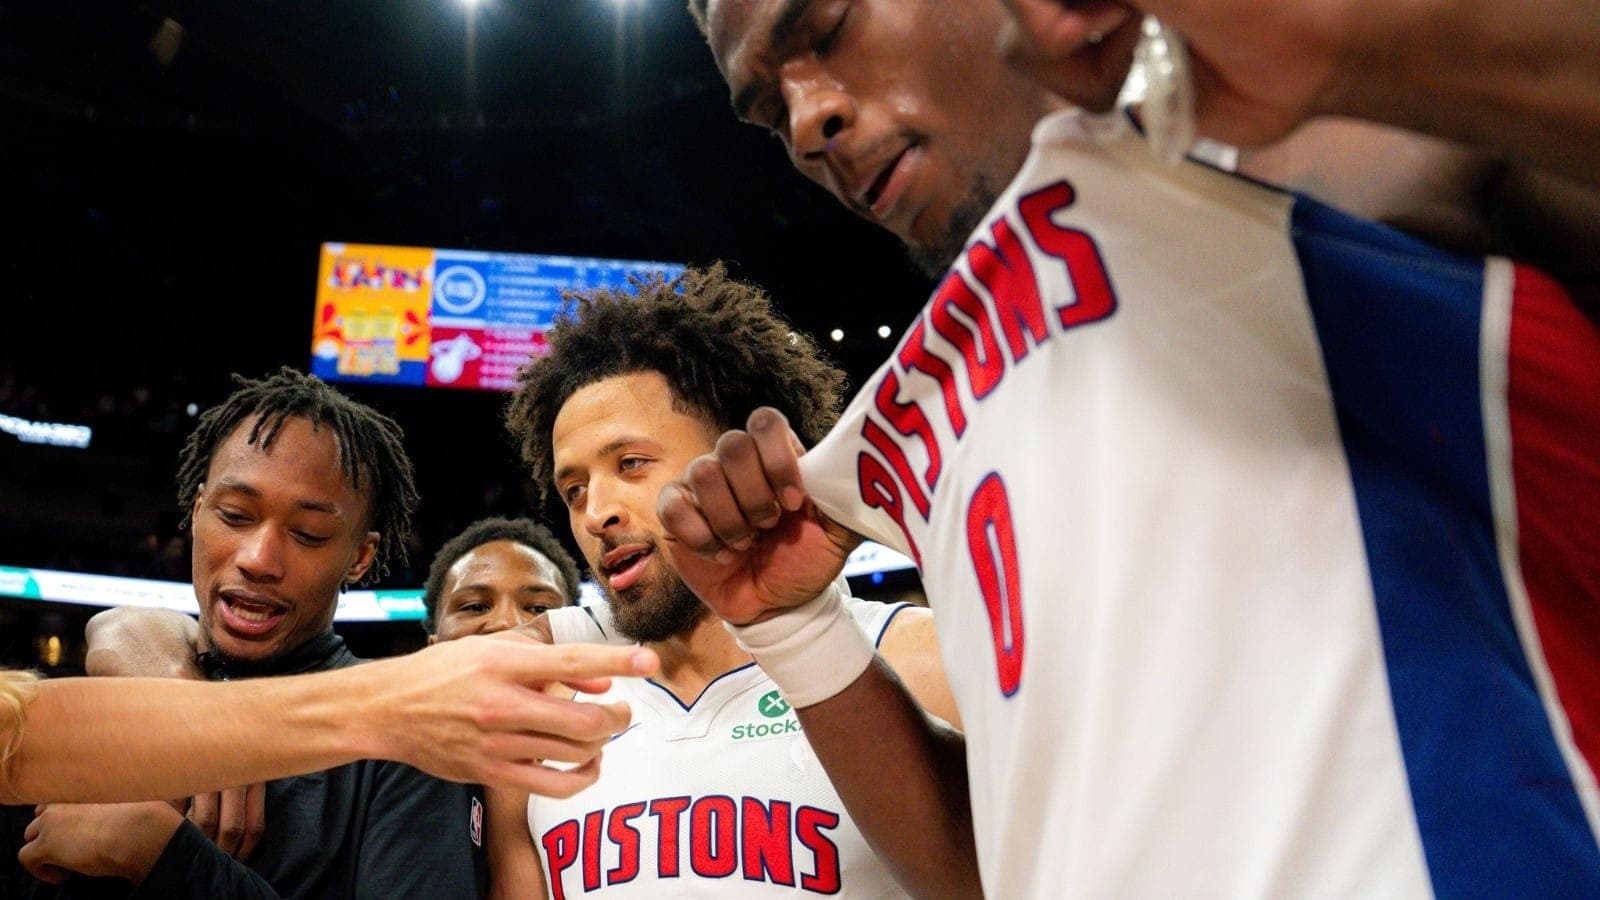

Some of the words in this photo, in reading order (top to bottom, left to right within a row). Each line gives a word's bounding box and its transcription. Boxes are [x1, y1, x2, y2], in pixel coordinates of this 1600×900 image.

[857, 179, 1119, 573] PISTONS
[966, 471, 1025, 699] 0
[731, 718, 804, 740] Stock
[541, 795, 842, 900] PISTONS
